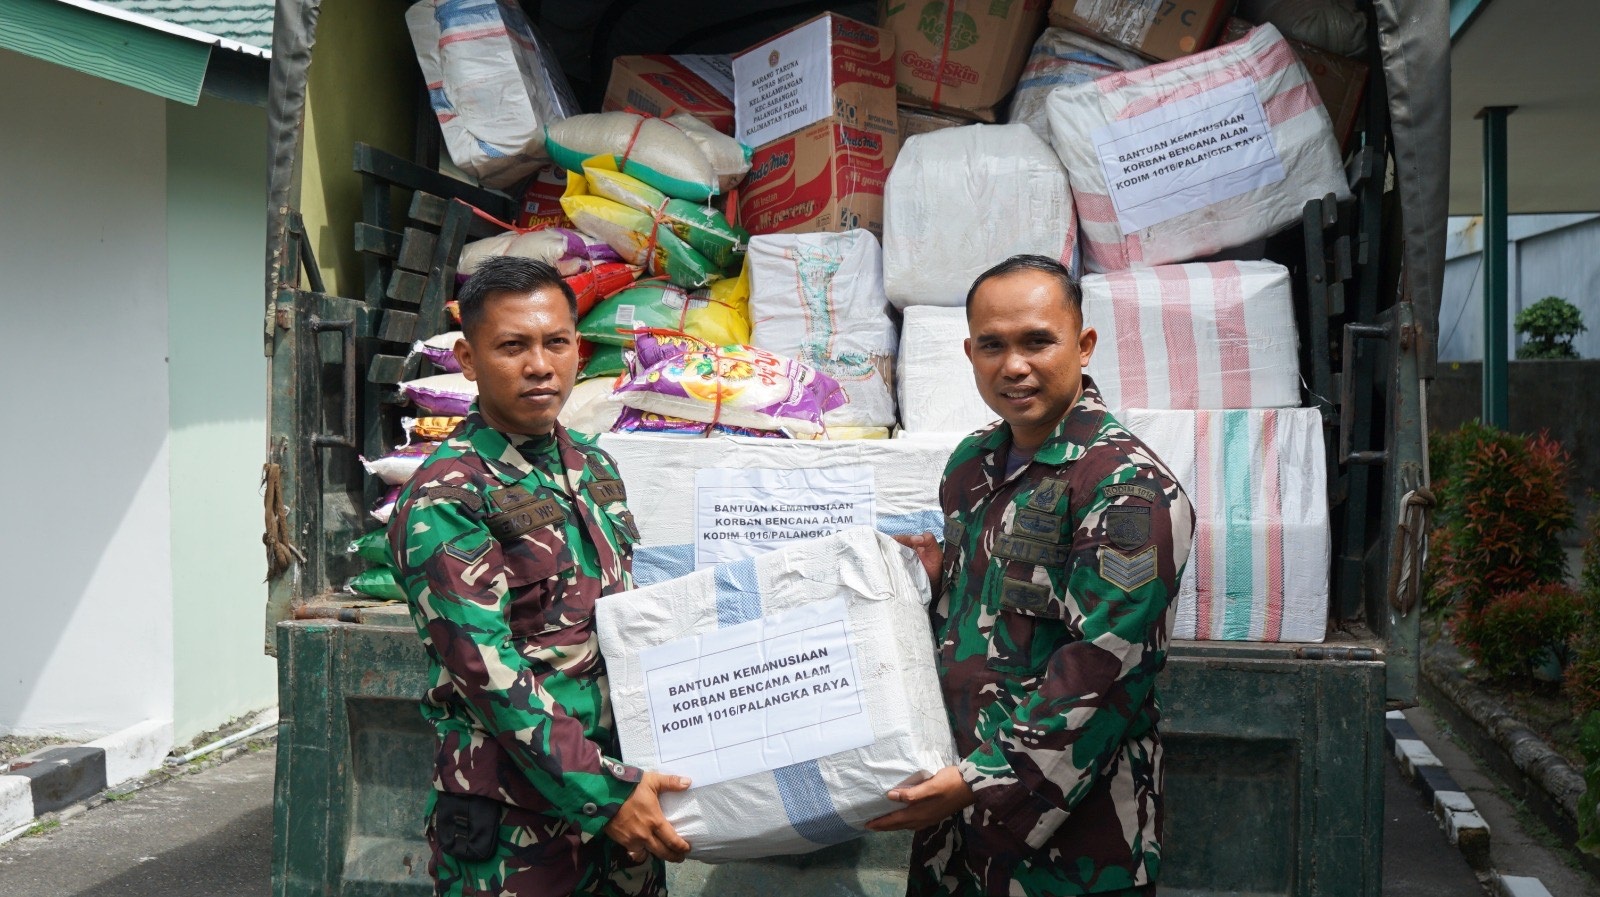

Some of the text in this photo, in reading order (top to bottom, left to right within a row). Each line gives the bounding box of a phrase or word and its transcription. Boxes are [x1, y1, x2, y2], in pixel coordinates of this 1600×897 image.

[1181, 9, 1197, 27] C
[752, 60, 799, 87] KARANG TARUNA
[758, 72, 794, 93] TUNAS MUDA
[844, 61, 890, 84] Mi goreng
[746, 104, 808, 136] KALIMANTAN TENGAH
[753, 99, 799, 124] PALANGKA RAYA
[1119, 114, 1245, 163] BANTUAN KEMANUSIAAN
[1123, 126, 1249, 174] KORBAN BENCANA ALAM
[747, 151, 790, 185] ndomie
[1116, 134, 1263, 190] KODIM 1016/PALANGKA RAYA
[752, 192, 778, 209] Mi Instan
[758, 211, 772, 230] Mi
[773, 199, 815, 227] goreng
[1104, 486, 1155, 502] KODIM 1016
[714, 502, 854, 513] BANTUAN KEMANUSIAAN
[503, 512, 532, 533] EKO
[715, 515, 853, 527] KORBAN BENCANA ALAM
[703, 532, 740, 541] KODIM
[744, 531, 832, 540] 1016/PALANGKA
[1000, 537, 1032, 560] TNI
[668, 647, 829, 697] BANTUAN KEMANUSIAAN
[672, 664, 831, 714] KORBAN BENCANA ALAM
[662, 677, 850, 733] KODIM 1016/PALANGKA RAYA
